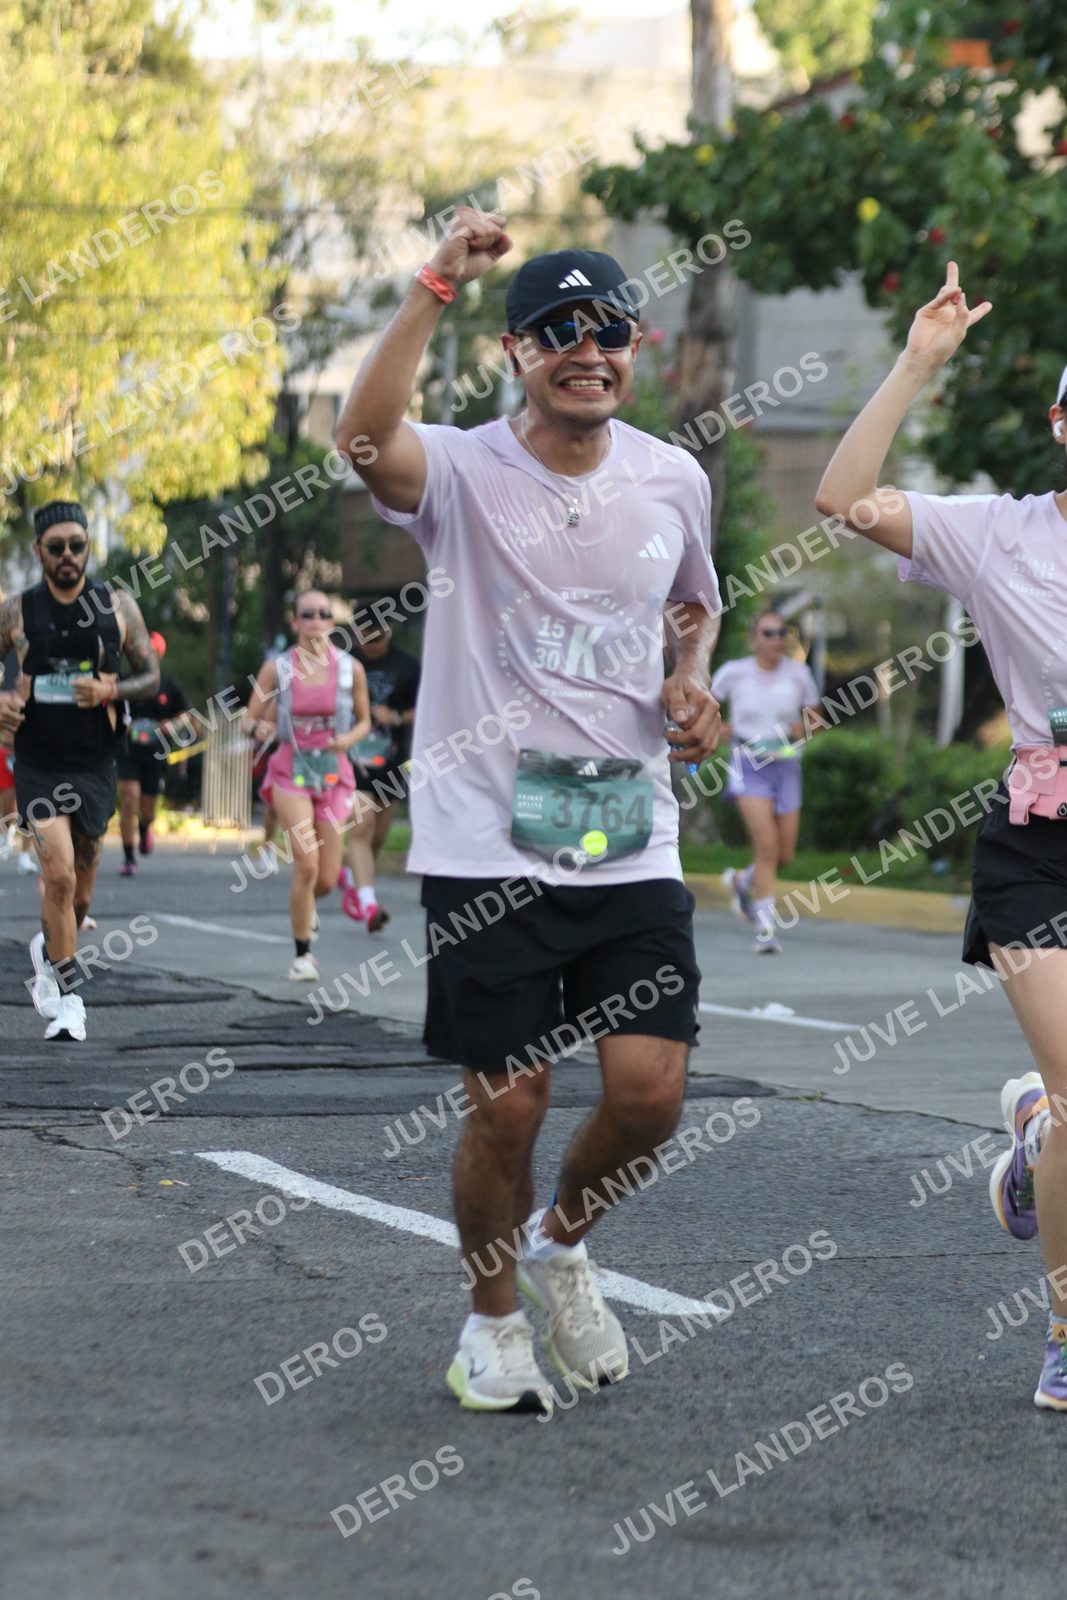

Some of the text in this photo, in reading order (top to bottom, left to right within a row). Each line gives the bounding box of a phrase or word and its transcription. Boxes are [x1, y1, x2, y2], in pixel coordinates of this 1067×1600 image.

[538, 614, 566, 639] 15
[532, 647, 561, 672] 30
[565, 623, 603, 680] K
[550, 788, 648, 835] 3764
